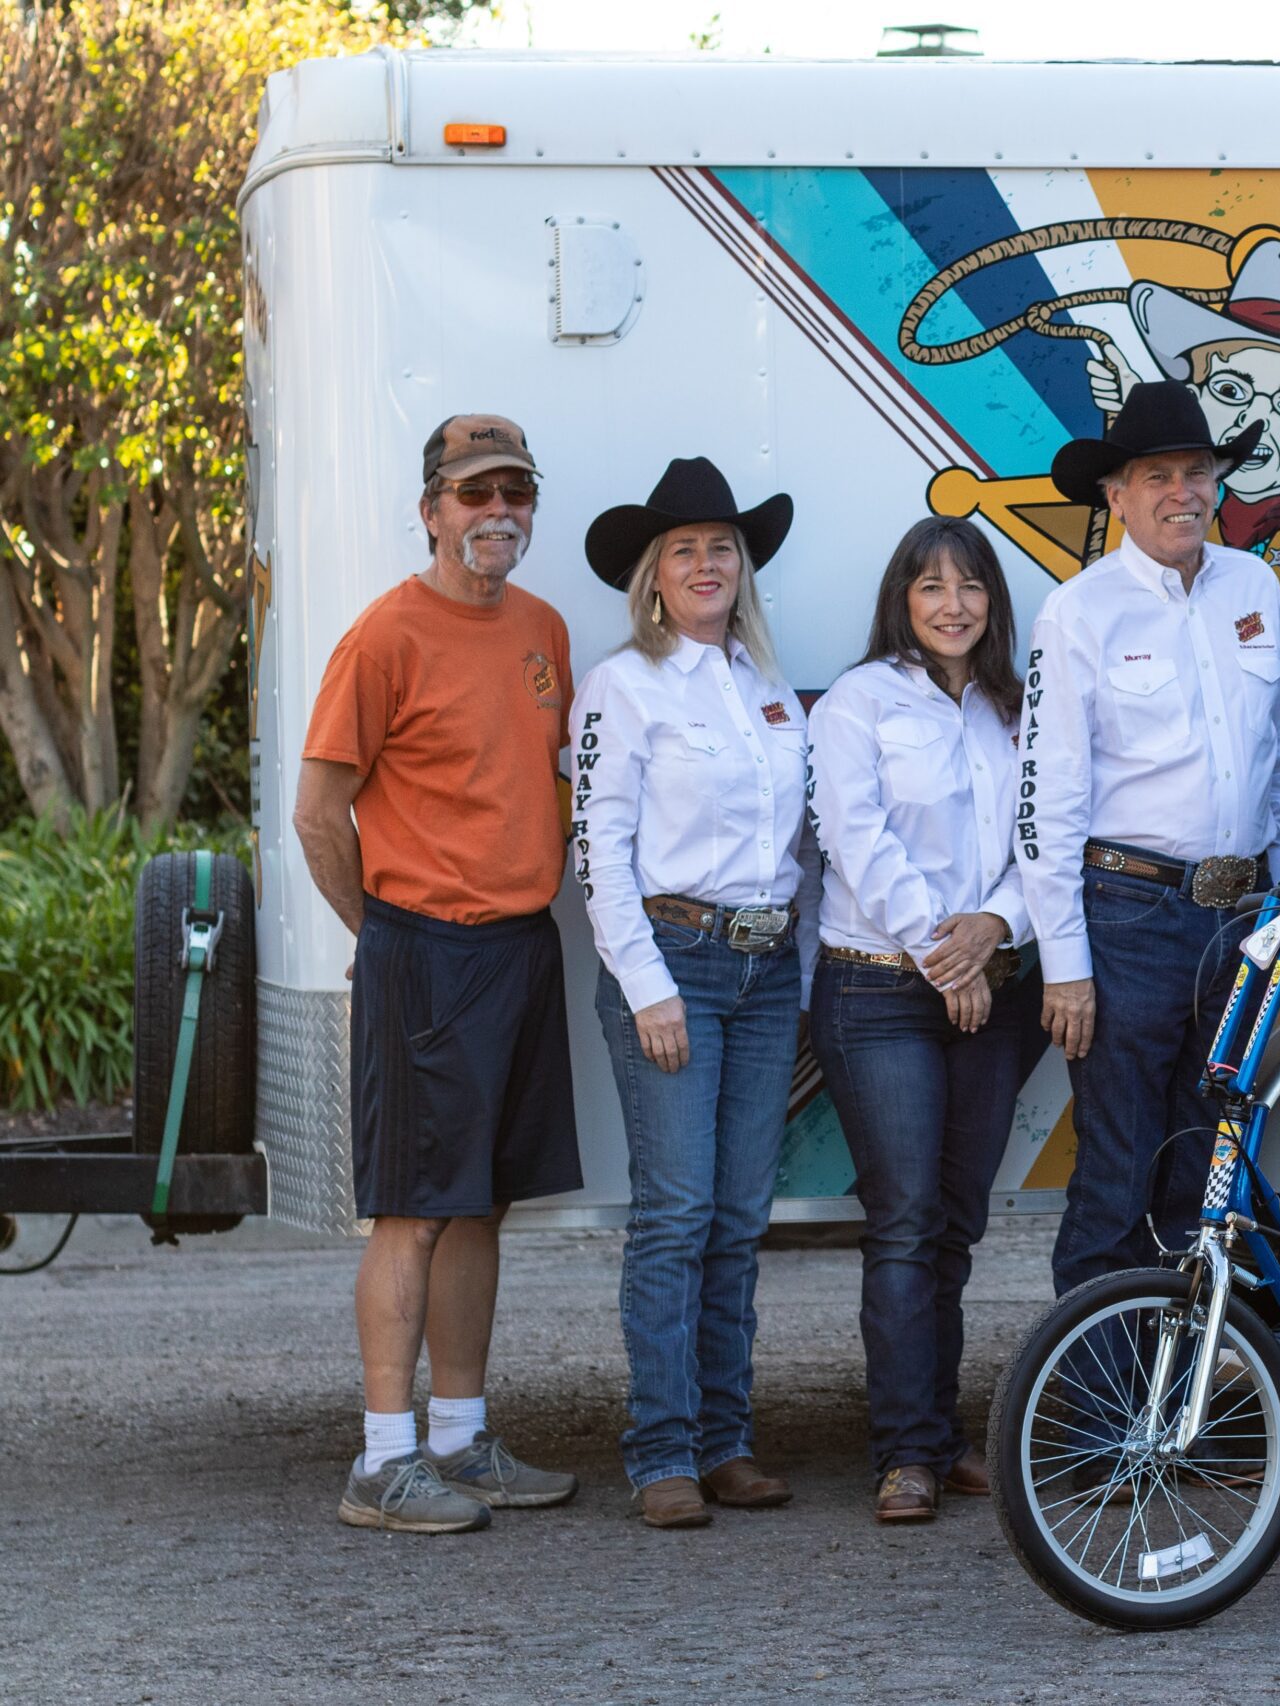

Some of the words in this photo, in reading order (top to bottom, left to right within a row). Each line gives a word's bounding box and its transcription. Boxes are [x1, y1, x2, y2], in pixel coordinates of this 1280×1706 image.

[1027, 649, 1043, 749] POWAY
[576, 713, 602, 811] POWAY
[1017, 760, 1039, 860] RODEO
